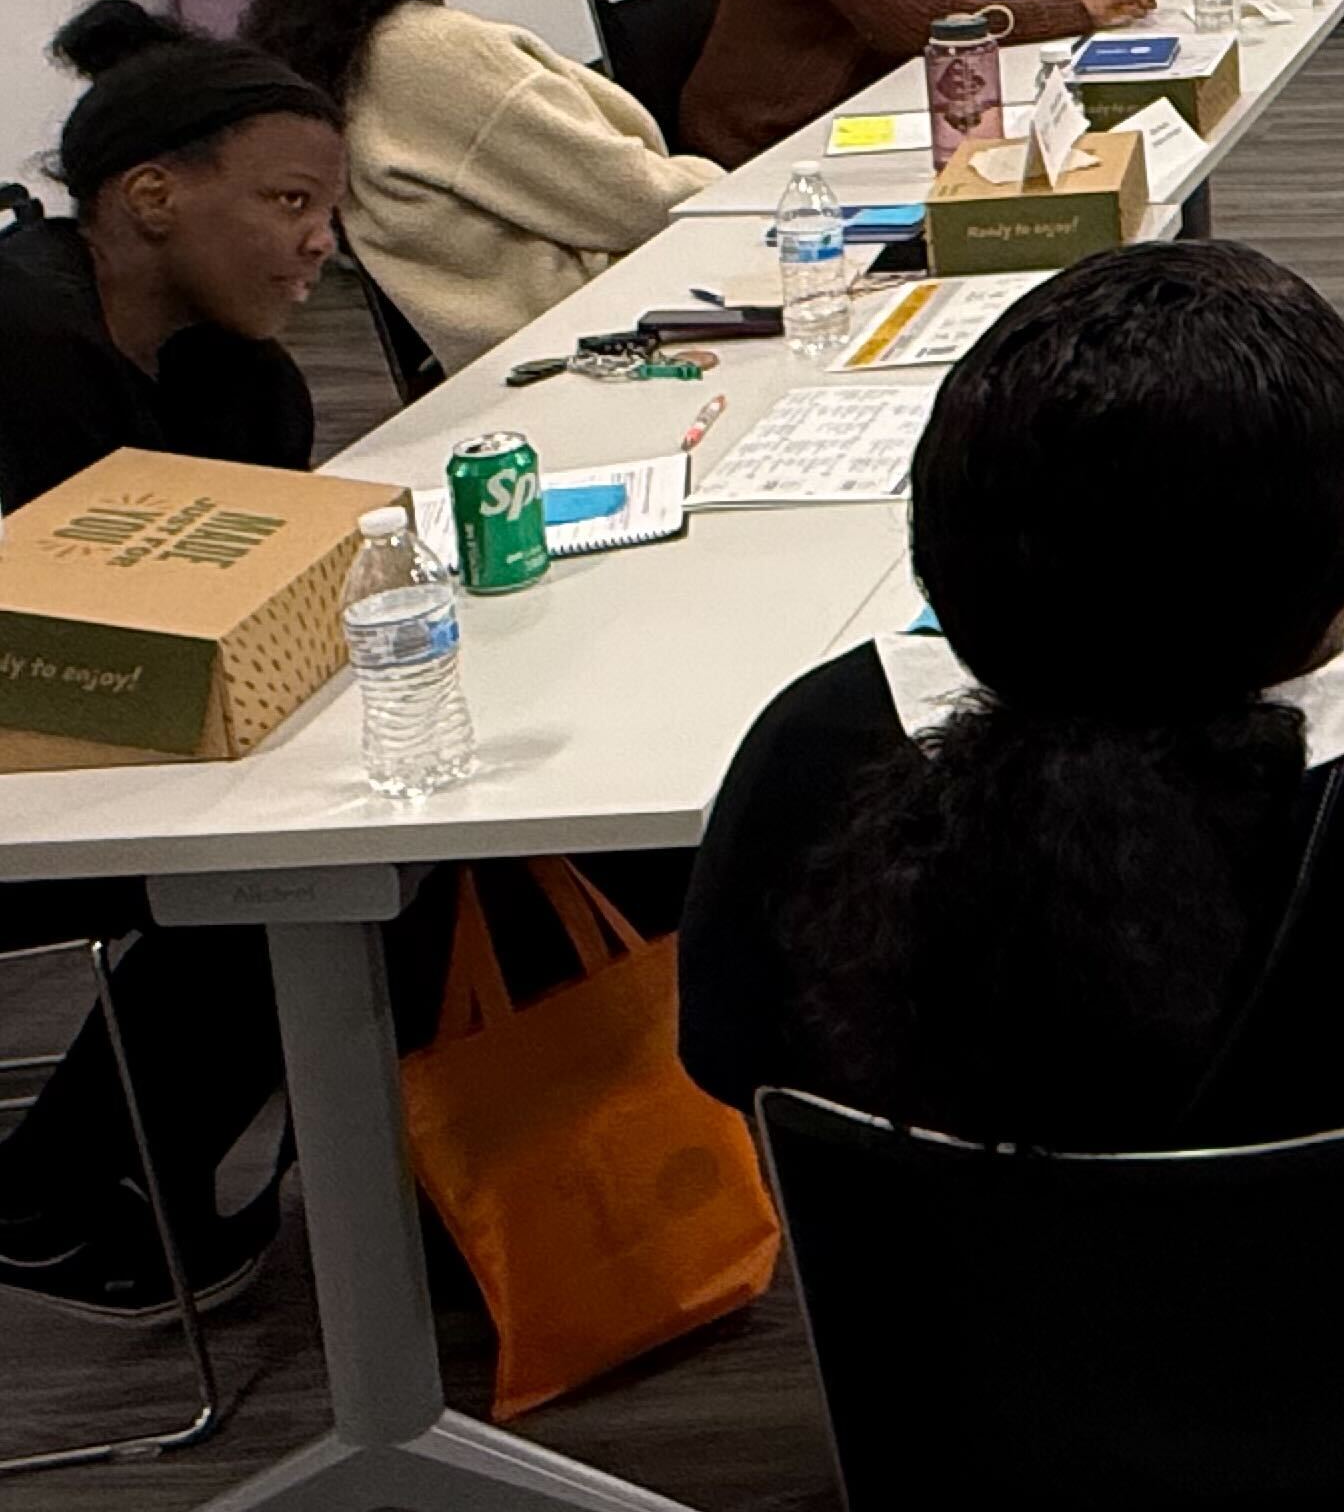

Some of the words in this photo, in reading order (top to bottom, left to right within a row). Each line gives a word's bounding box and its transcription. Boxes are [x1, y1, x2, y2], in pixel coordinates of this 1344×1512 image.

[479, 468, 541, 522] Sp
[31, 656, 57, 678] to
[61, 664, 144, 693] enjoy!
